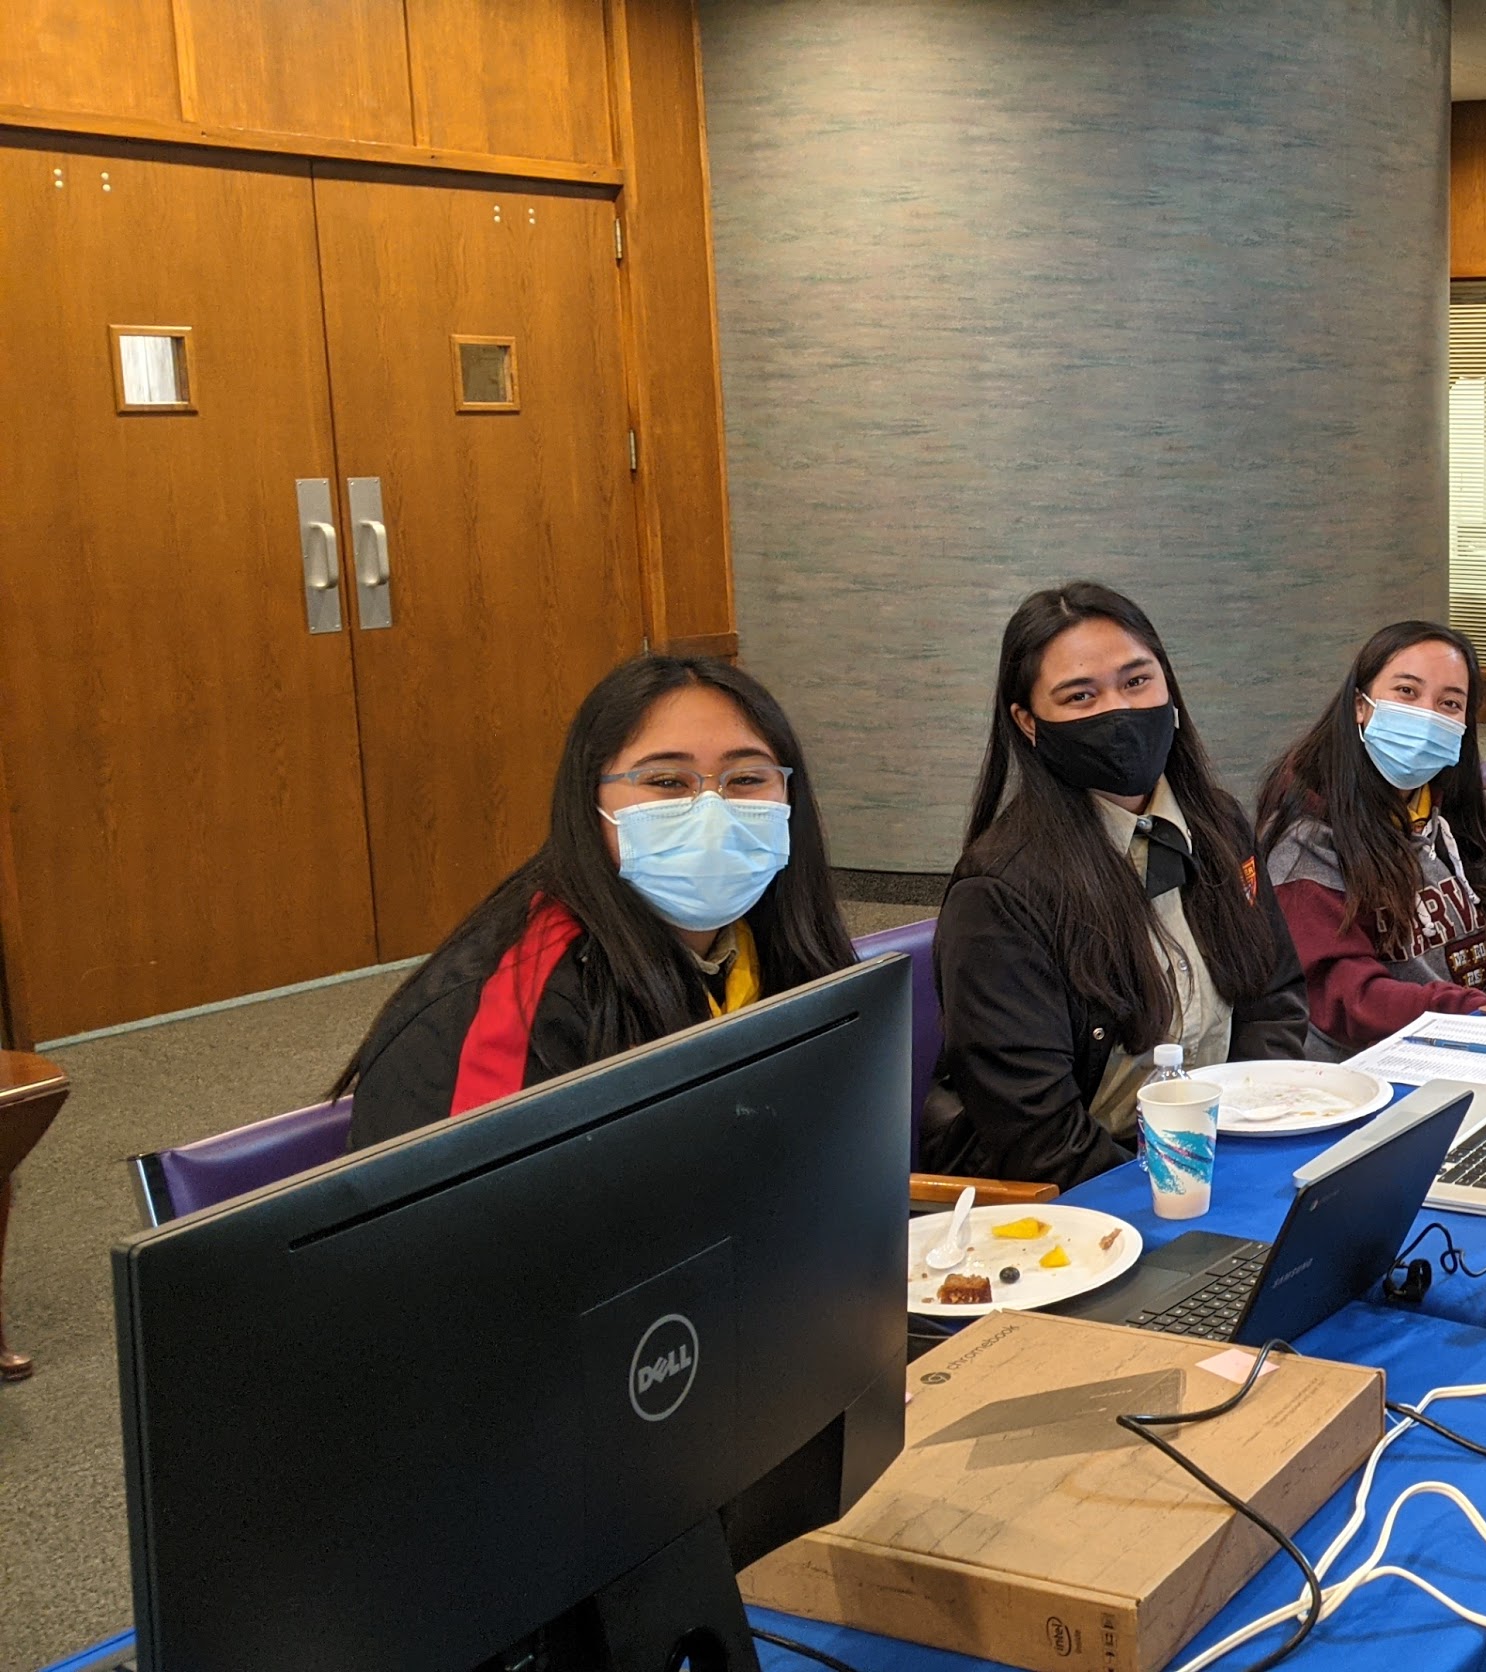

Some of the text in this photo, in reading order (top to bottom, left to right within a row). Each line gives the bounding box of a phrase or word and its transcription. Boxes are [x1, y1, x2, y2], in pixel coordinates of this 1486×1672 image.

[638, 1344, 692, 1394] DELL
[947, 1324, 1020, 1371] chromebook
[1051, 1622, 1064, 1651] intel
